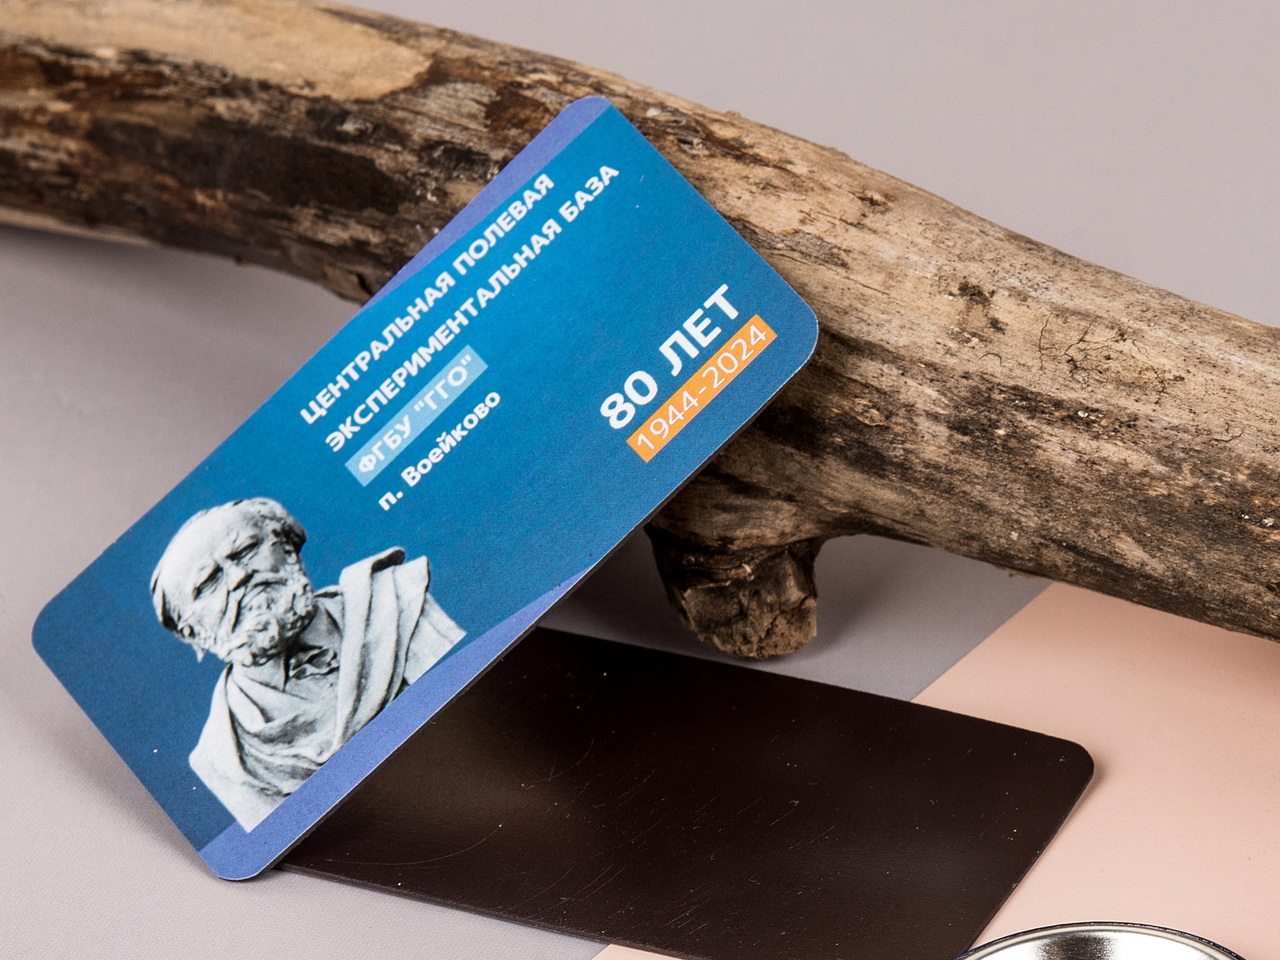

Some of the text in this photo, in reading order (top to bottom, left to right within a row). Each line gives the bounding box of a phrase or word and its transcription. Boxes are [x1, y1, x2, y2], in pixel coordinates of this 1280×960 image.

[300, 173, 555, 425] ЦЕНТРАЛЬНАЯ ПОЛЕВАЯ
[325, 165, 619, 452] ЭКСПЕРИМЕНТАЛЬНАЯ БАЗА
[601, 284, 739, 430] 80 ЛЕТ
[357, 354, 473, 474] ФГБУ "ГГО"
[378, 392, 501, 511] п. Воейково
[636, 324, 768, 452] 1944-2024
